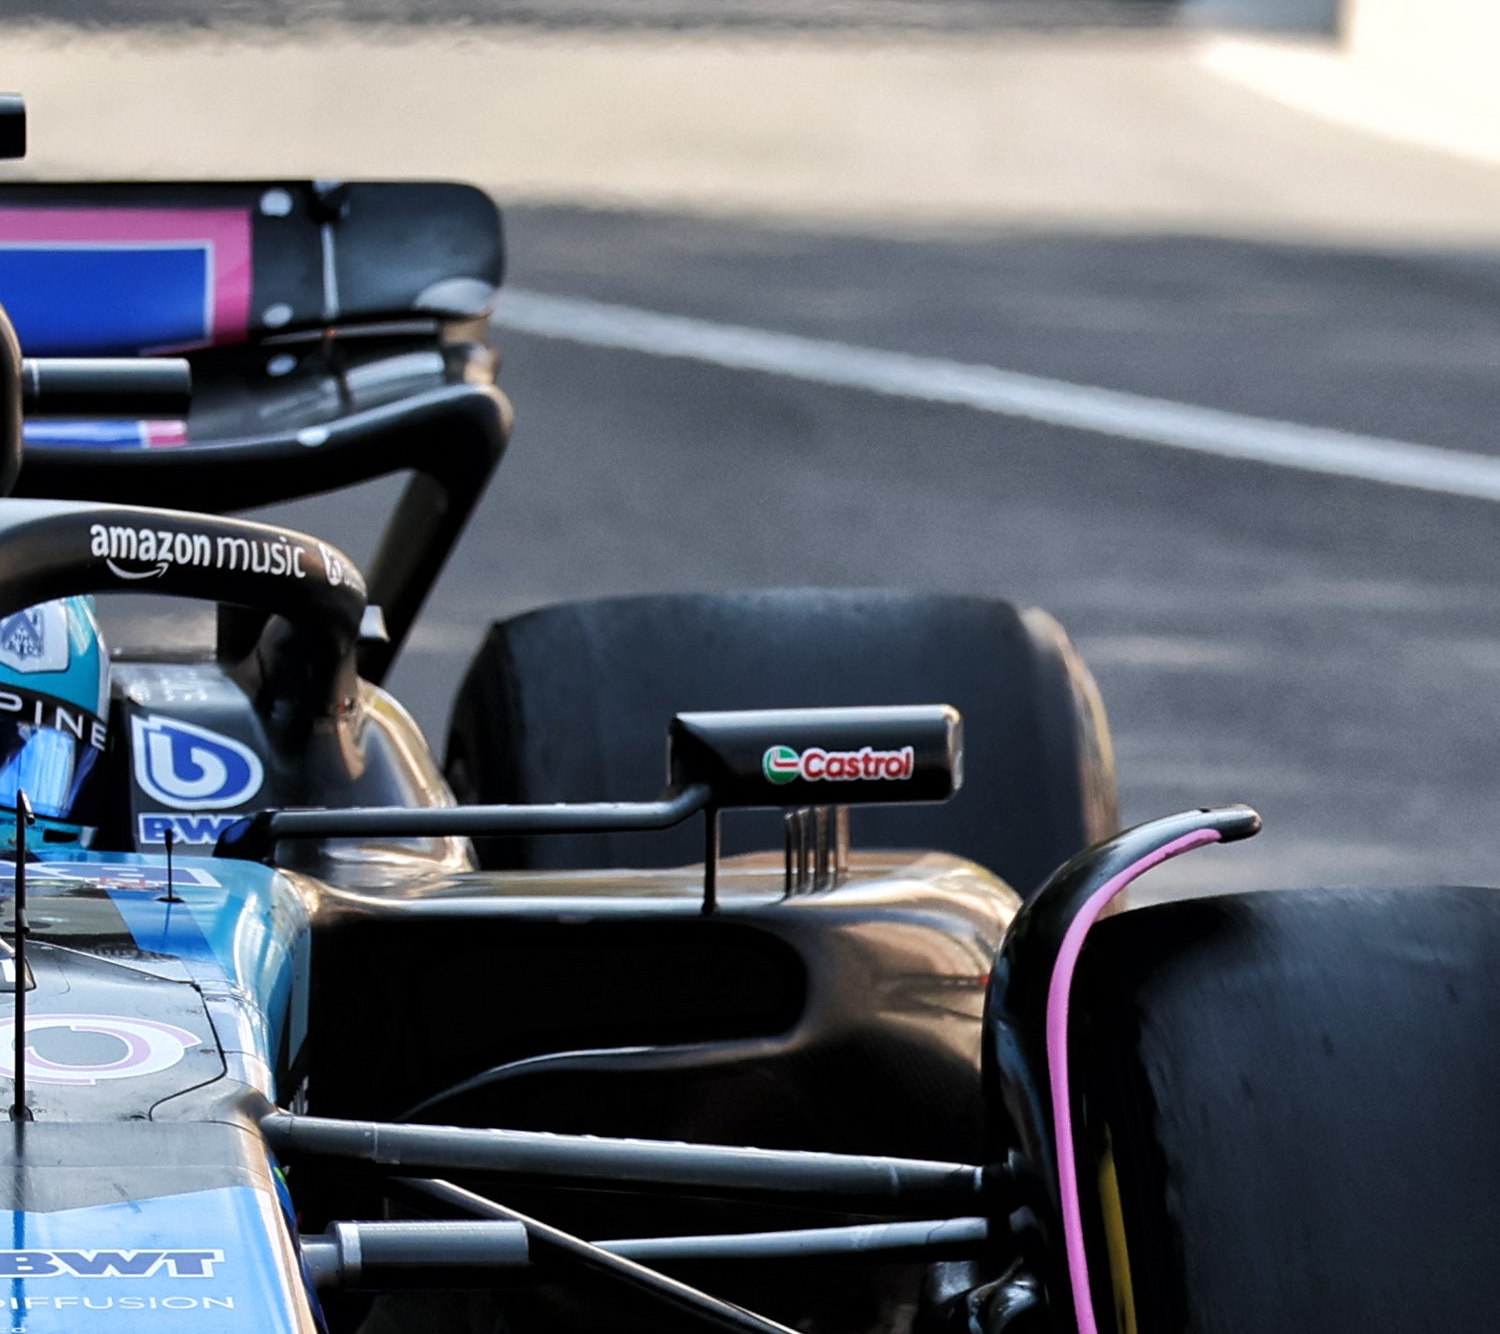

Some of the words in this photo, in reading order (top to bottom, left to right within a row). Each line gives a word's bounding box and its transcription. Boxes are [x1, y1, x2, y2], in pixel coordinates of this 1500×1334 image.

[90, 524, 211, 567] amazon
[217, 535, 307, 578] music
[801, 747, 914, 781] Castrol
[139, 813, 245, 845] BW
